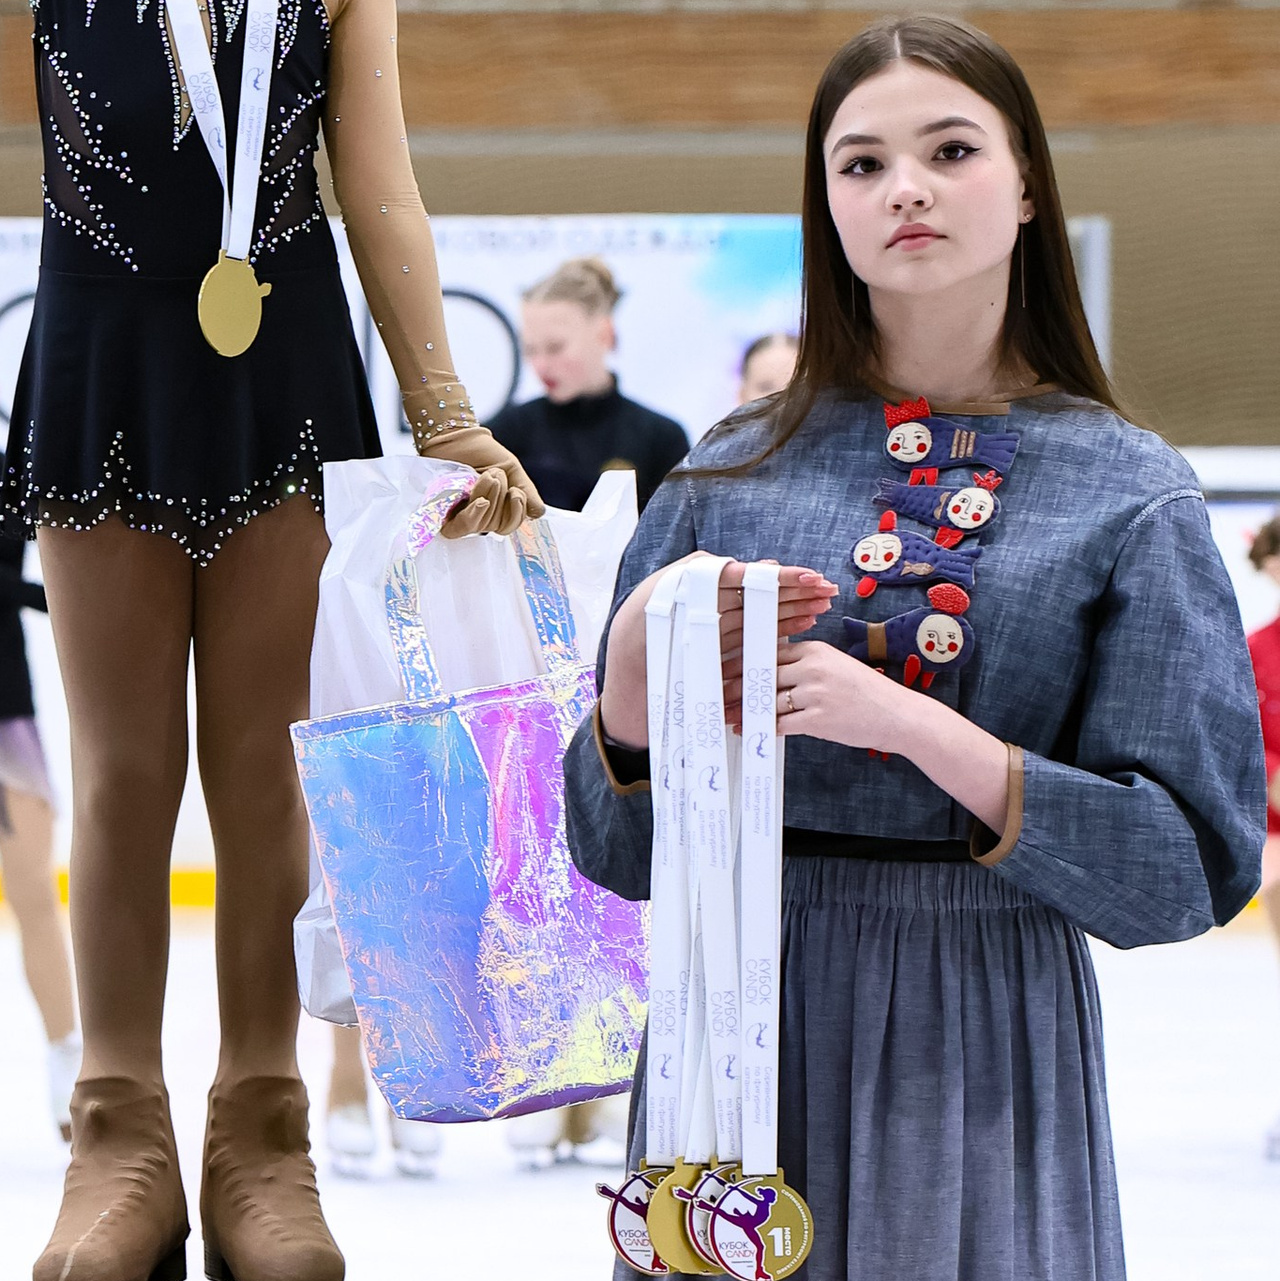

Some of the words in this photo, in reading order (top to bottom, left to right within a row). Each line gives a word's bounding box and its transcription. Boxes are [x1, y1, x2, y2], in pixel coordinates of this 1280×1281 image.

[249, 11, 261, 52] CANDY
[259, 12, 273, 53] КУБОК
[189, 75, 208, 114] CANDY
[200, 72, 219, 112] КУБОК
[674, 681, 684, 728] CANDY
[746, 667, 759, 715] CANDY
[760, 668, 773, 715] КУБОК
[695, 702, 708, 748] CANDY
[708, 702, 722, 749] КУБОК
[745, 958, 758, 1005] CANDY
[759, 958, 772, 1005] КУБОК
[652, 990, 663, 1036] CANDY
[664, 990, 676, 1036] КУБОК
[710, 992, 724, 1038] CANDY
[723, 990, 738, 1036] КУБОК
[618, 1229, 649, 1238] КУБОК
[624, 1237, 651, 1247] CAND
[718, 1241, 749, 1250] КУБОК
[725, 1249, 756, 1258] CANDY
[767, 1227, 784, 1256] 1
